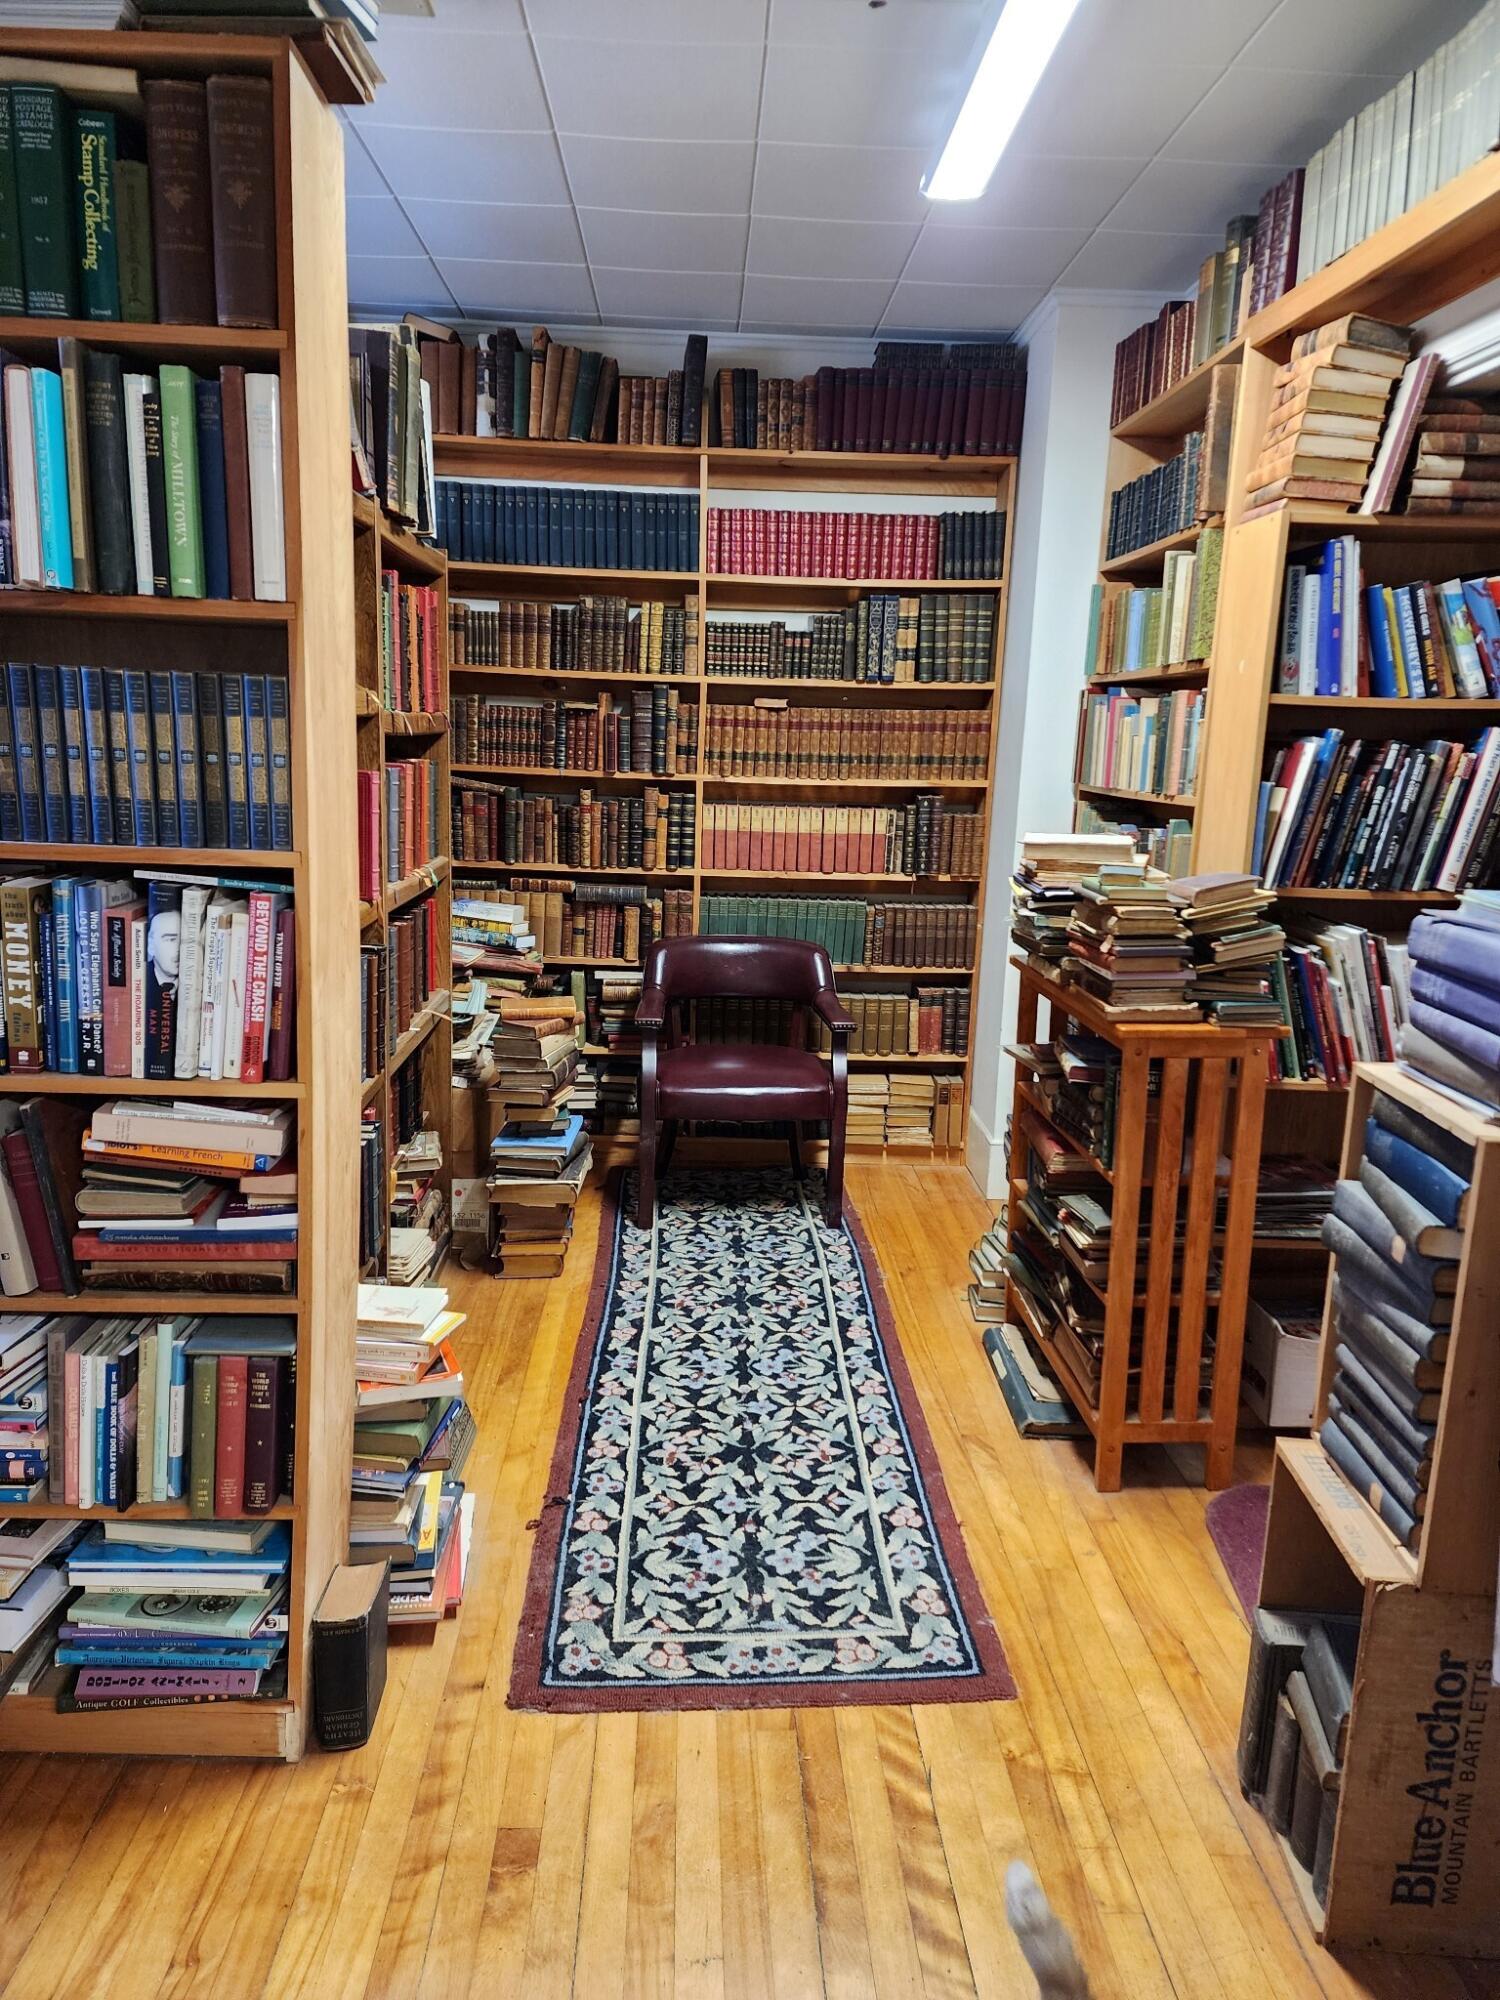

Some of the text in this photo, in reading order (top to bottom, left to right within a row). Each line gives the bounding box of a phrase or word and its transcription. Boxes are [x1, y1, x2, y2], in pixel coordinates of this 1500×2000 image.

[96, 134, 108, 175] Standard
[102, 223, 112, 234] of
[78, 133, 103, 271] Stamp Collecting
[37, 431, 48, 448] City
[170, 415, 187, 547] The Story of MILLTOWN
[1415, 588, 1428, 613] WHITE
[1420, 614, 1431, 636] GIRLS
[3, 892, 18, 900] the
[5, 901, 25, 909] truth
[4, 910, 27, 919] about
[56, 912, 70, 947] AGAINST
[79, 910, 89, 946] LOUIS
[186, 912, 197, 961] MILLIONAIRE
[80, 952, 89, 962] V.
[111, 919, 122, 978] The Affluent Society
[206, 916, 218, 997] The Frugal Superpower
[274, 932, 284, 961] TENDER
[5, 921, 32, 1010] MONEY
[58, 963, 71, 980] TIDE
[251, 900, 271, 1022] BEYOND THE CRASH
[89, 911, 102, 1055] Who Says Elephants Can't Dance?
[273, 962, 283, 988] OFFER
[21, 1022, 31, 1034] Ric
[149, 1009, 157, 1034] MAN
[160, 991, 171, 1054] UNIVERSAL
[82, 1034, 91, 1054] JR.
[243, 1036, 251, 1064] BROWN
[251, 1035, 261, 1065] GORDON
[107, 1141, 224, 1161] IDIOT'S Learning French
[68, 1387, 78, 1440] DOLL VALUES
[110, 1427, 117, 1437] OF
[109, 1438, 117, 1462] DOLLS
[109, 1462, 116, 1470] &
[109, 1470, 117, 1499] VALUES
[81, 1655, 241, 1667] American-Victorian Figural Napkin Rings
[86, 1676, 146, 1687] DOULTON
[150, 1675, 211, 1687] ANIMALS
[76, 1697, 189, 1710] Antique GOLF Collectibles
[322, 1711, 363, 1722] DICTIONARY
[325, 1720, 360, 1730] GERMAN
[324, 1728, 361, 1740] HEATH'S
[1390, 1648, 1469, 1908] Blue Anchor
[1441, 1658, 1493, 1905] MOUNTAIN BARTLETTS
